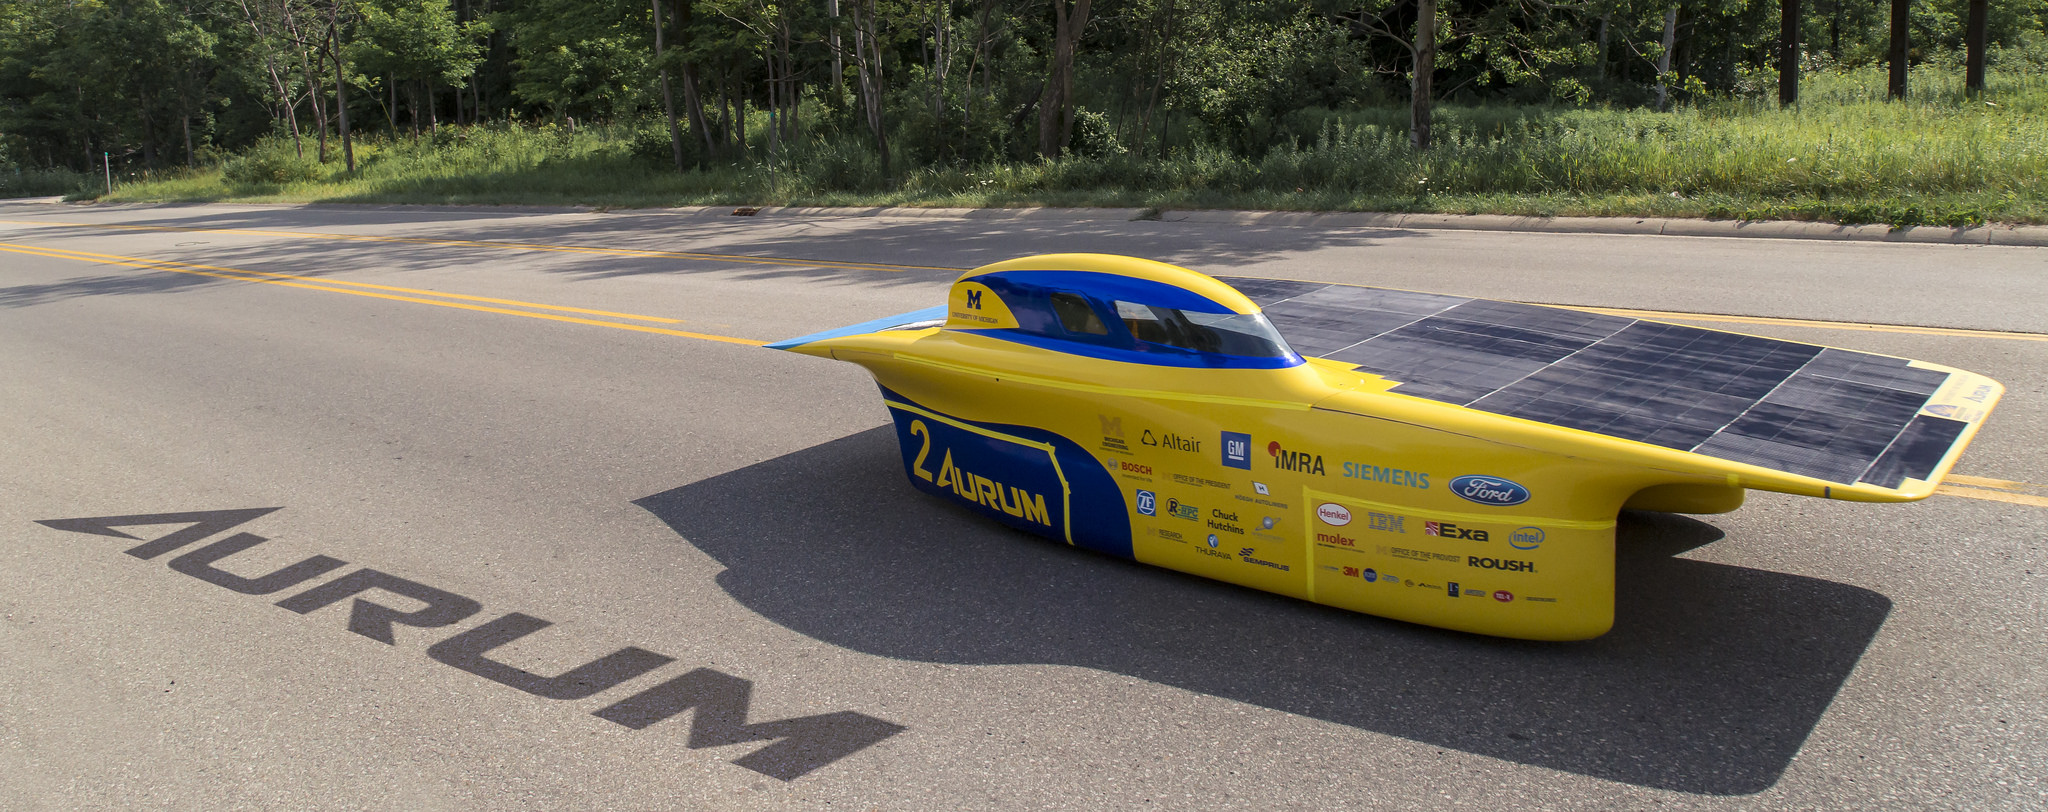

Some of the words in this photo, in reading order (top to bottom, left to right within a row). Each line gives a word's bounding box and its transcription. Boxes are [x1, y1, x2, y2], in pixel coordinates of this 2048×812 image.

[966, 289, 982, 310] M
[910, 419, 933, 483] 2
[1162, 433, 1201, 453] Altair
[1228, 440, 1245, 457] GM
[1121, 461, 1153, 475] BOSCH
[1342, 461, 1430, 490] SIEMENS
[936, 447, 1051, 527] AURUM
[1173, 473, 1188, 481] OFFICE
[1196, 477, 1204, 485] THE
[1205, 479, 1231, 489] PRESIDENT
[1464, 478, 1514, 502] Ford
[1139, 495, 1154, 511] ZF
[1212, 508, 1239, 522] Chuck
[1319, 508, 1349, 521] Henkel
[1368, 511, 1406, 534] IBM
[1159, 528, 1183, 539] RESEARCH
[1207, 519, 1245, 535] Hutchins
[1439, 522, 1489, 542] Exa
[1317, 533, 1356, 547] molex
[1513, 530, 1540, 544] intel
[1194, 546, 1233, 560] THURAYA
[1391, 547, 1410, 556] OFFICE
[1411, 549, 1419, 557] OF
[1420, 551, 1431, 559] THE
[1432, 553, 1461, 563] PROVOST
[1243, 556, 1290, 572] SEMPRIUS
[1342, 566, 1359, 578] 3M
[1468, 556, 1534, 573] ROUSH
[35, 506, 907, 783] AURUM
